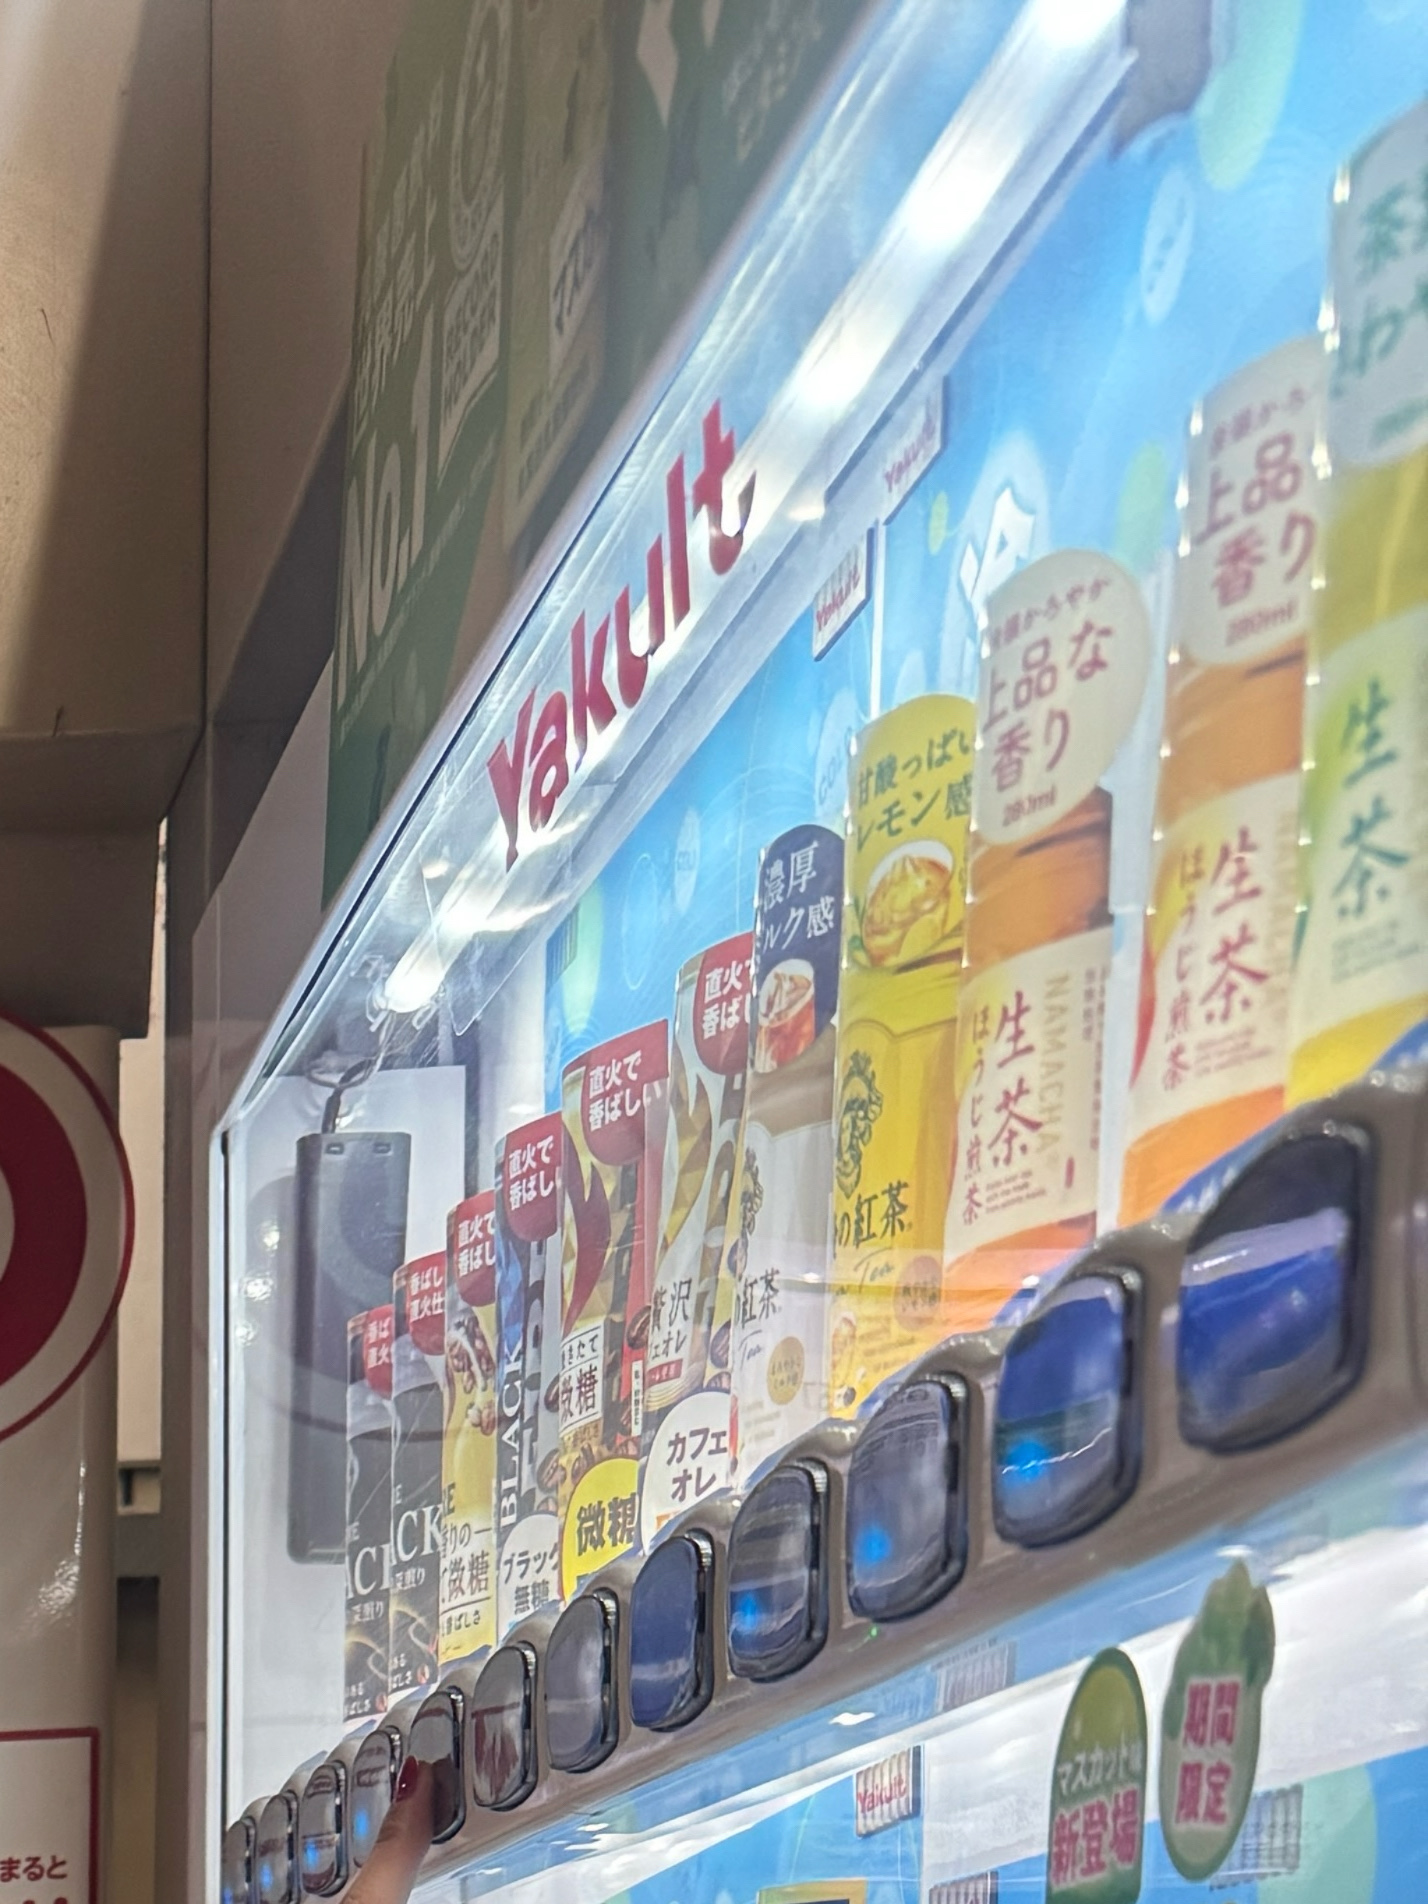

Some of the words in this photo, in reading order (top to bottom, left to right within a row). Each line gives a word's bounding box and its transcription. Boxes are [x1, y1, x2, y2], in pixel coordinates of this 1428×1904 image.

[1211, 512, 1316, 609] 香り
[486, 397, 758, 874] Yakult
[983, 621, 1115, 734] 上品な
[991, 708, 1070, 793] 香り
[1329, 677, 1412, 921] 生茶
[763, 841, 820, 914] 濃厚
[1197, 825, 1271, 1027] 生茶
[588, 1049, 642, 1098] 直火で
[984, 989, 1043, 1169] 生茶
[508, 1134, 555, 1178] 直火で
[500, 1338, 523, 1529] BLACK
[664, 1424, 728, 1468] カフェ
[671, 1456, 716, 1501] オレ
[576, 1492, 637, 1557] 微糖
[448, 1550, 489, 1600] 微糖
[1182, 1678, 1242, 1746] 期間
[856, 1770, 910, 1815] Yakult
[1174, 1762, 1235, 1830] 限定
[1047, 1786, 1141, 1886] 新登場
